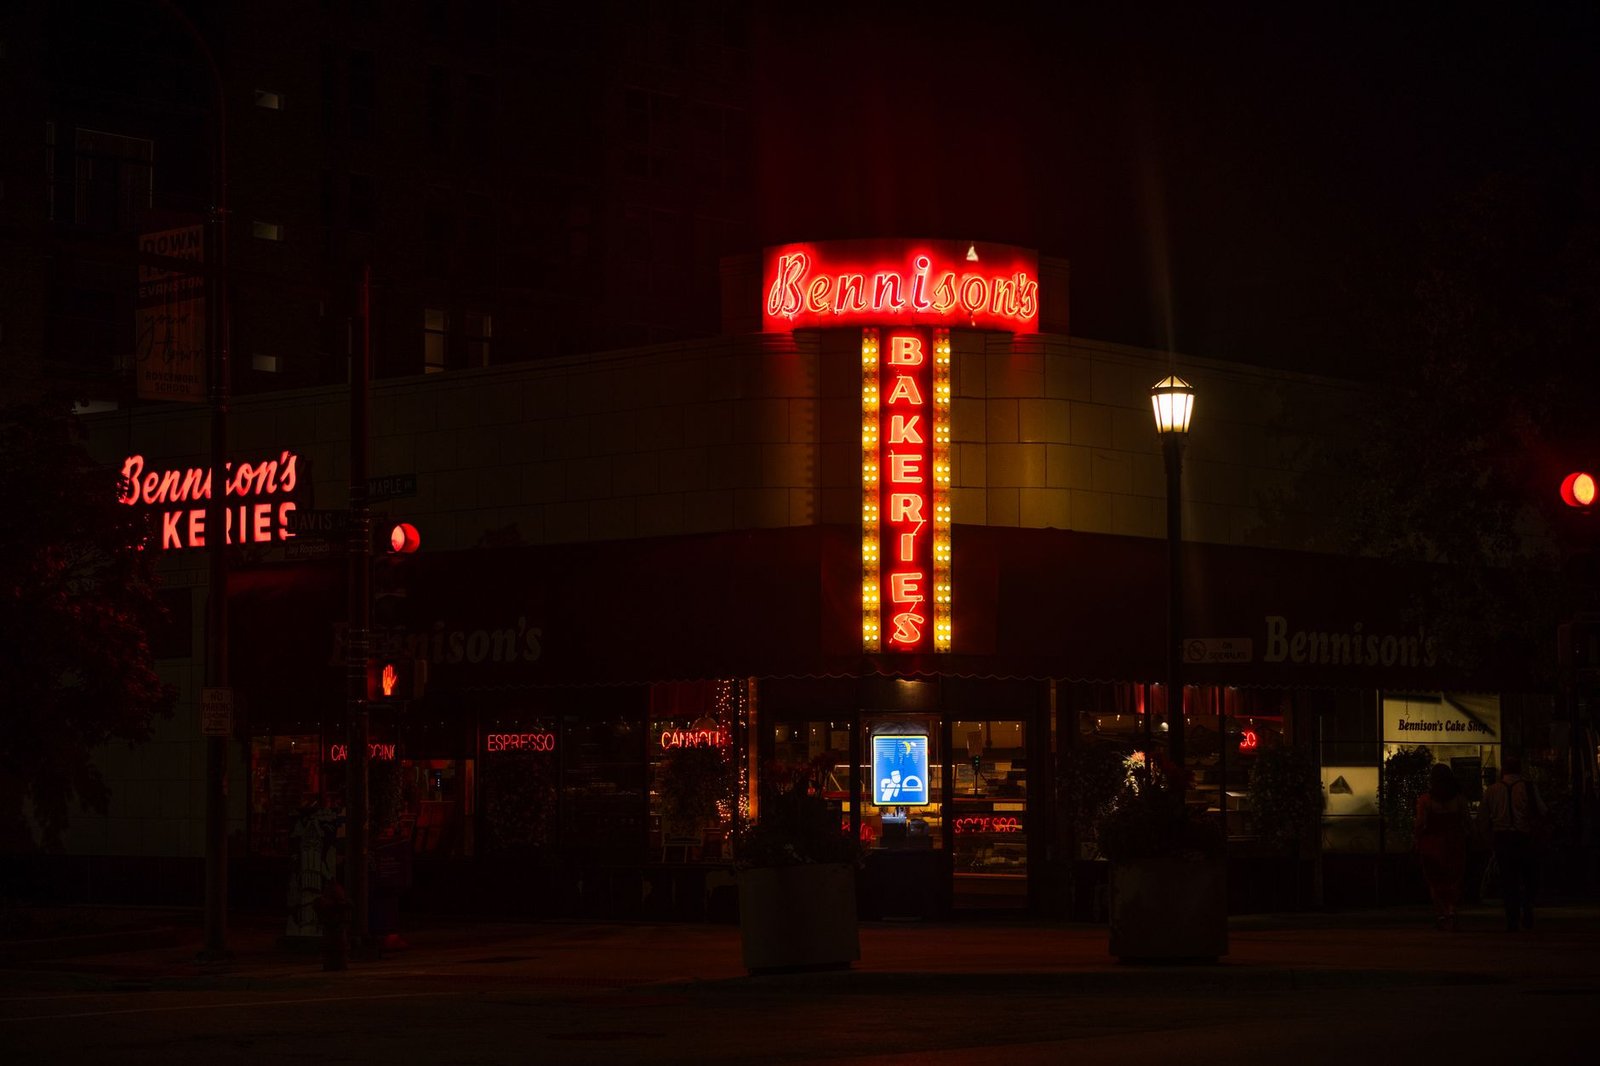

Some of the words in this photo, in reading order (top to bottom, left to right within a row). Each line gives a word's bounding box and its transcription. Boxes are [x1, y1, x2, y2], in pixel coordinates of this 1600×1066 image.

[138, 276, 204, 299] EVANSTON
[767, 253, 1038, 318] Bennison's
[154, 382, 191, 394] SCHOOL
[368, 475, 403, 496] MAPLE
[888, 336, 925, 644] BAKERIES
[288, 511, 333, 530] DAVIS
[1263, 615, 1439, 668] Bennison's
[1398, 719, 1443, 732] Bennison's
[1445, 720, 1465, 732] Cake
[1467, 720, 1489, 734] Shop
[487, 734, 555, 752] ESPRESSO
